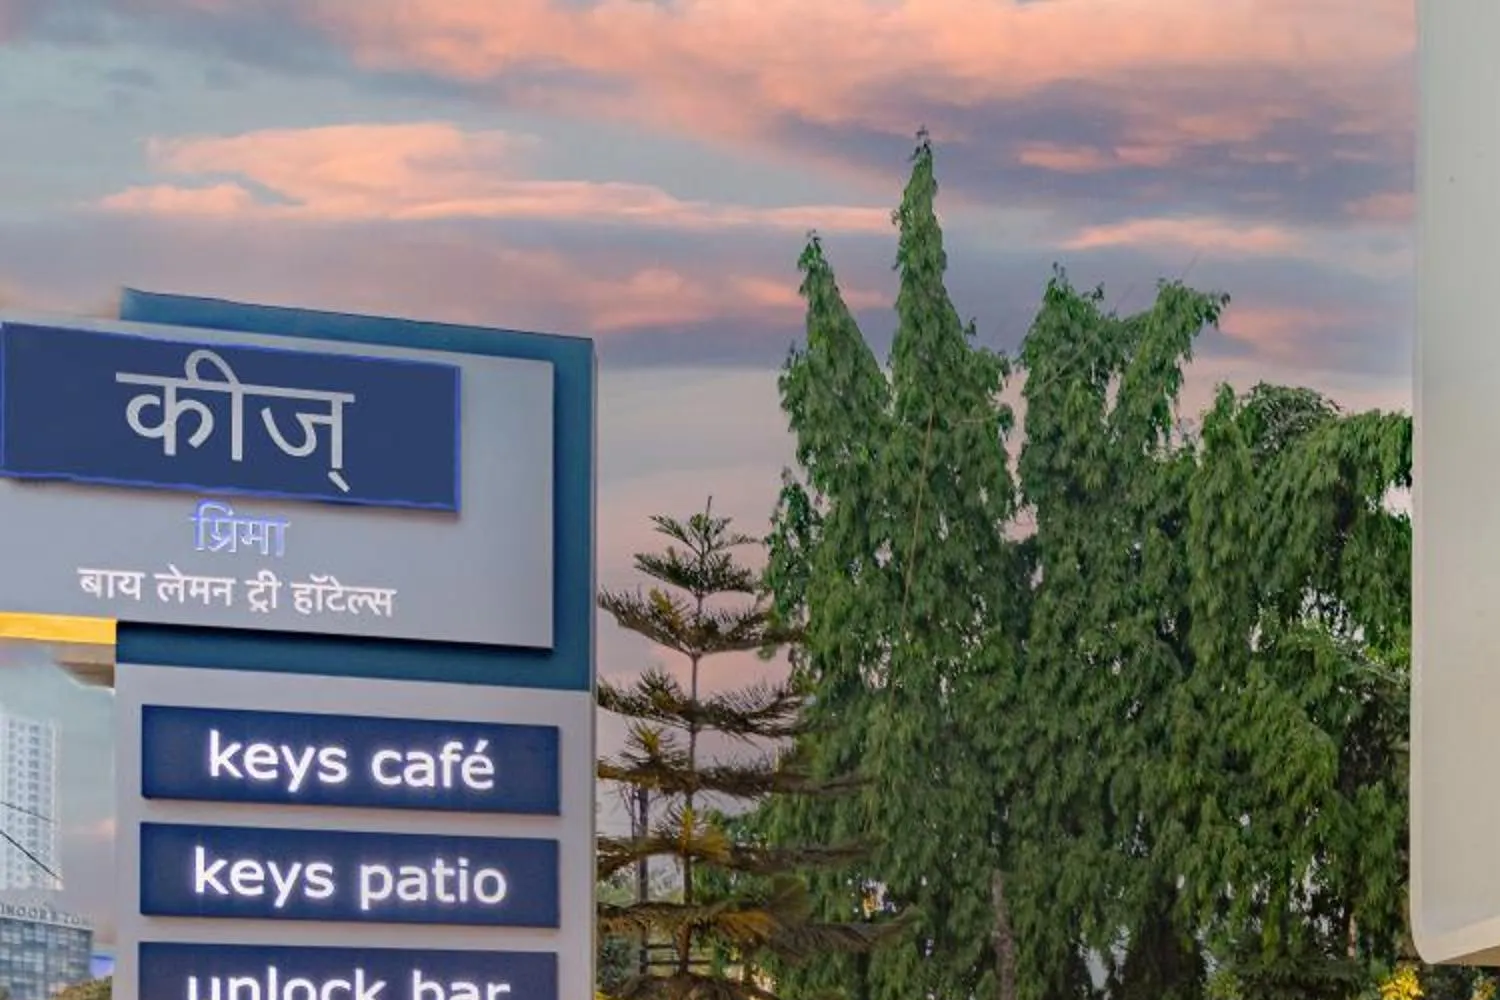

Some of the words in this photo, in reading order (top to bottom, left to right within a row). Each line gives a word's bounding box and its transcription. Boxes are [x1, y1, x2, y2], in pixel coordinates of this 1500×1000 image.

[115, 349, 355, 492] कीज्
[189, 499, 291, 557] प्रिमा
[77, 567, 145, 601] बाय
[153, 564, 236, 607] लेमन
[244, 570, 282, 613] ट्री
[290, 574, 397, 618] हॉटेल्स
[208, 729, 349, 793] keys
[370, 739, 497, 791] café
[193, 845, 336, 908] keys
[359, 857, 508, 910] patio
